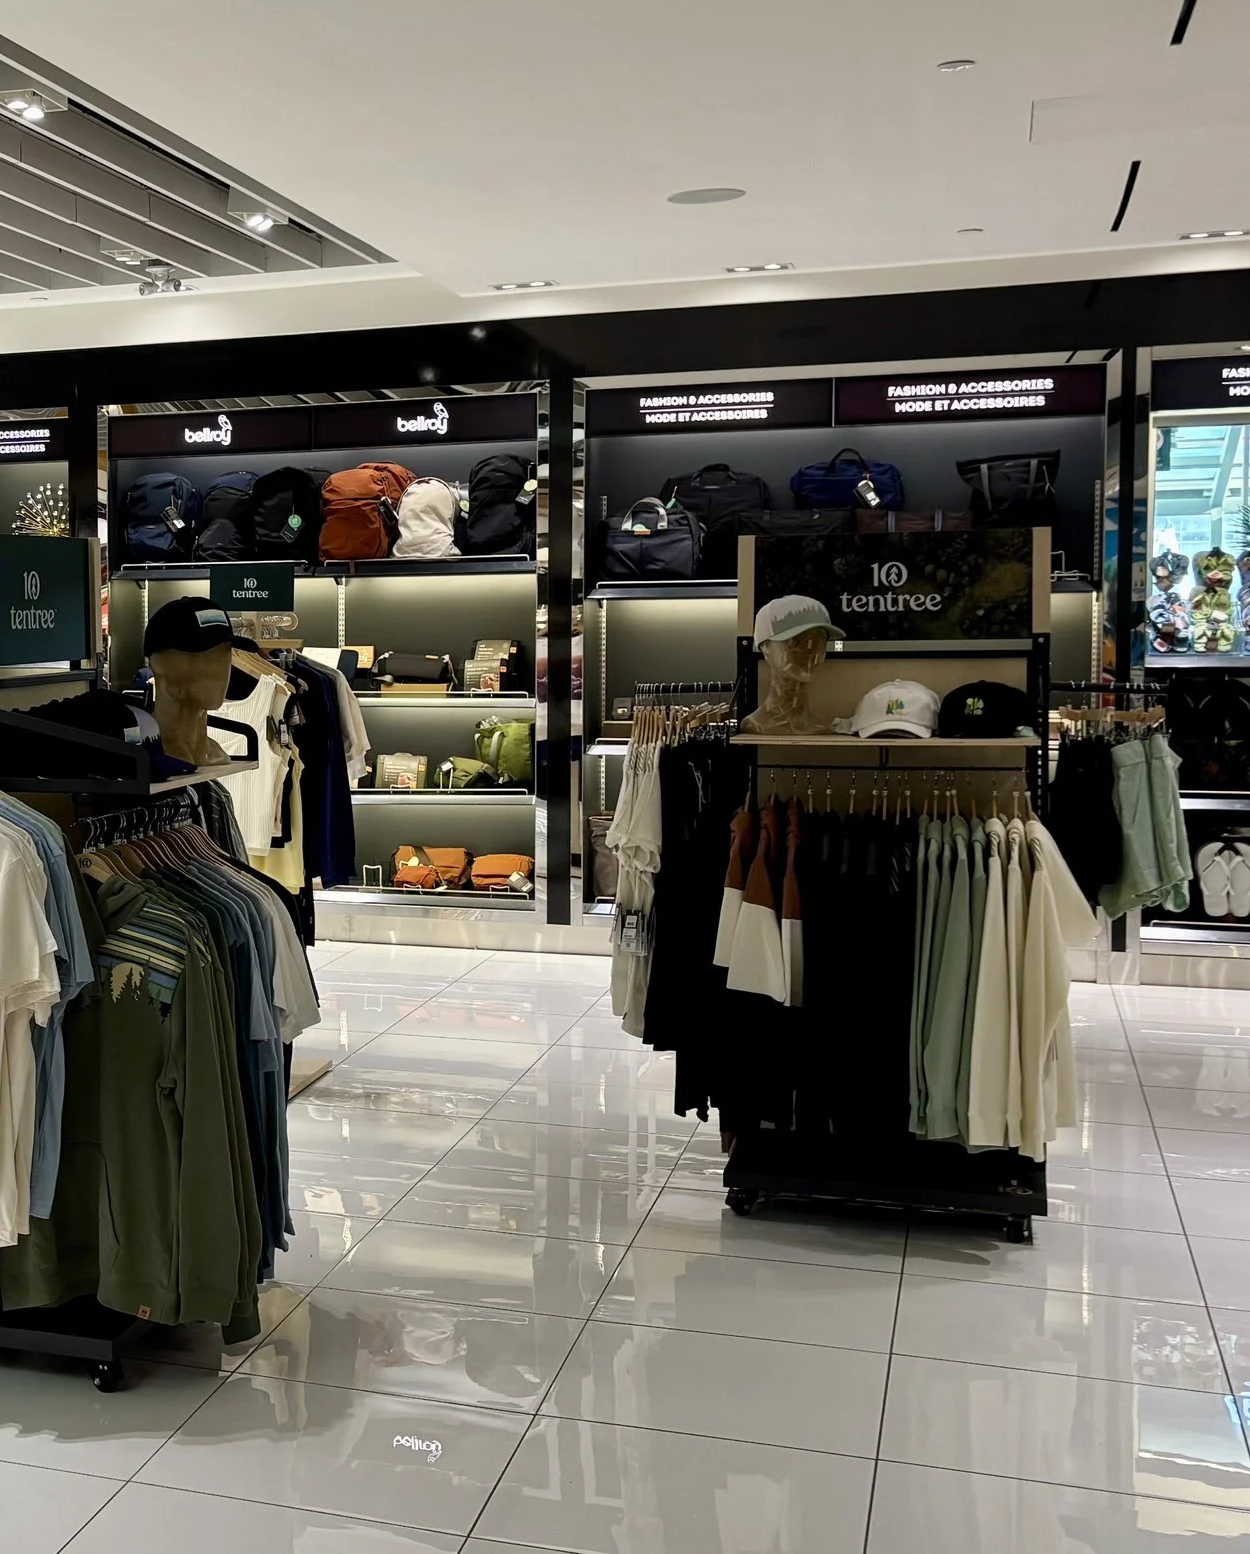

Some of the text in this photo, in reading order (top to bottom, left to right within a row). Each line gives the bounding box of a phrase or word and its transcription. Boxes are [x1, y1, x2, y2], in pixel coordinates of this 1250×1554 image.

[888, 383, 946, 397] FASHION
[958, 378, 1054, 394] ACCESSORIES
[639, 396, 688, 407] FASHION
[697, 392, 774, 404] ACCESSORIES
[894, 395, 1046, 413] MODE ET ACCESSOIRES
[397, 415, 448, 435] bellroy
[645, 409, 768, 423] MODE ET ACCESSOIRES
[184, 426, 232, 446] bellroy
[243, 577, 257, 589] 10
[870, 561, 909, 587] 10
[23, 570, 41, 600] 10
[232, 589, 269, 598] tentree
[839, 591, 942, 613] tentree
[10, 605, 55, 630] tentree
